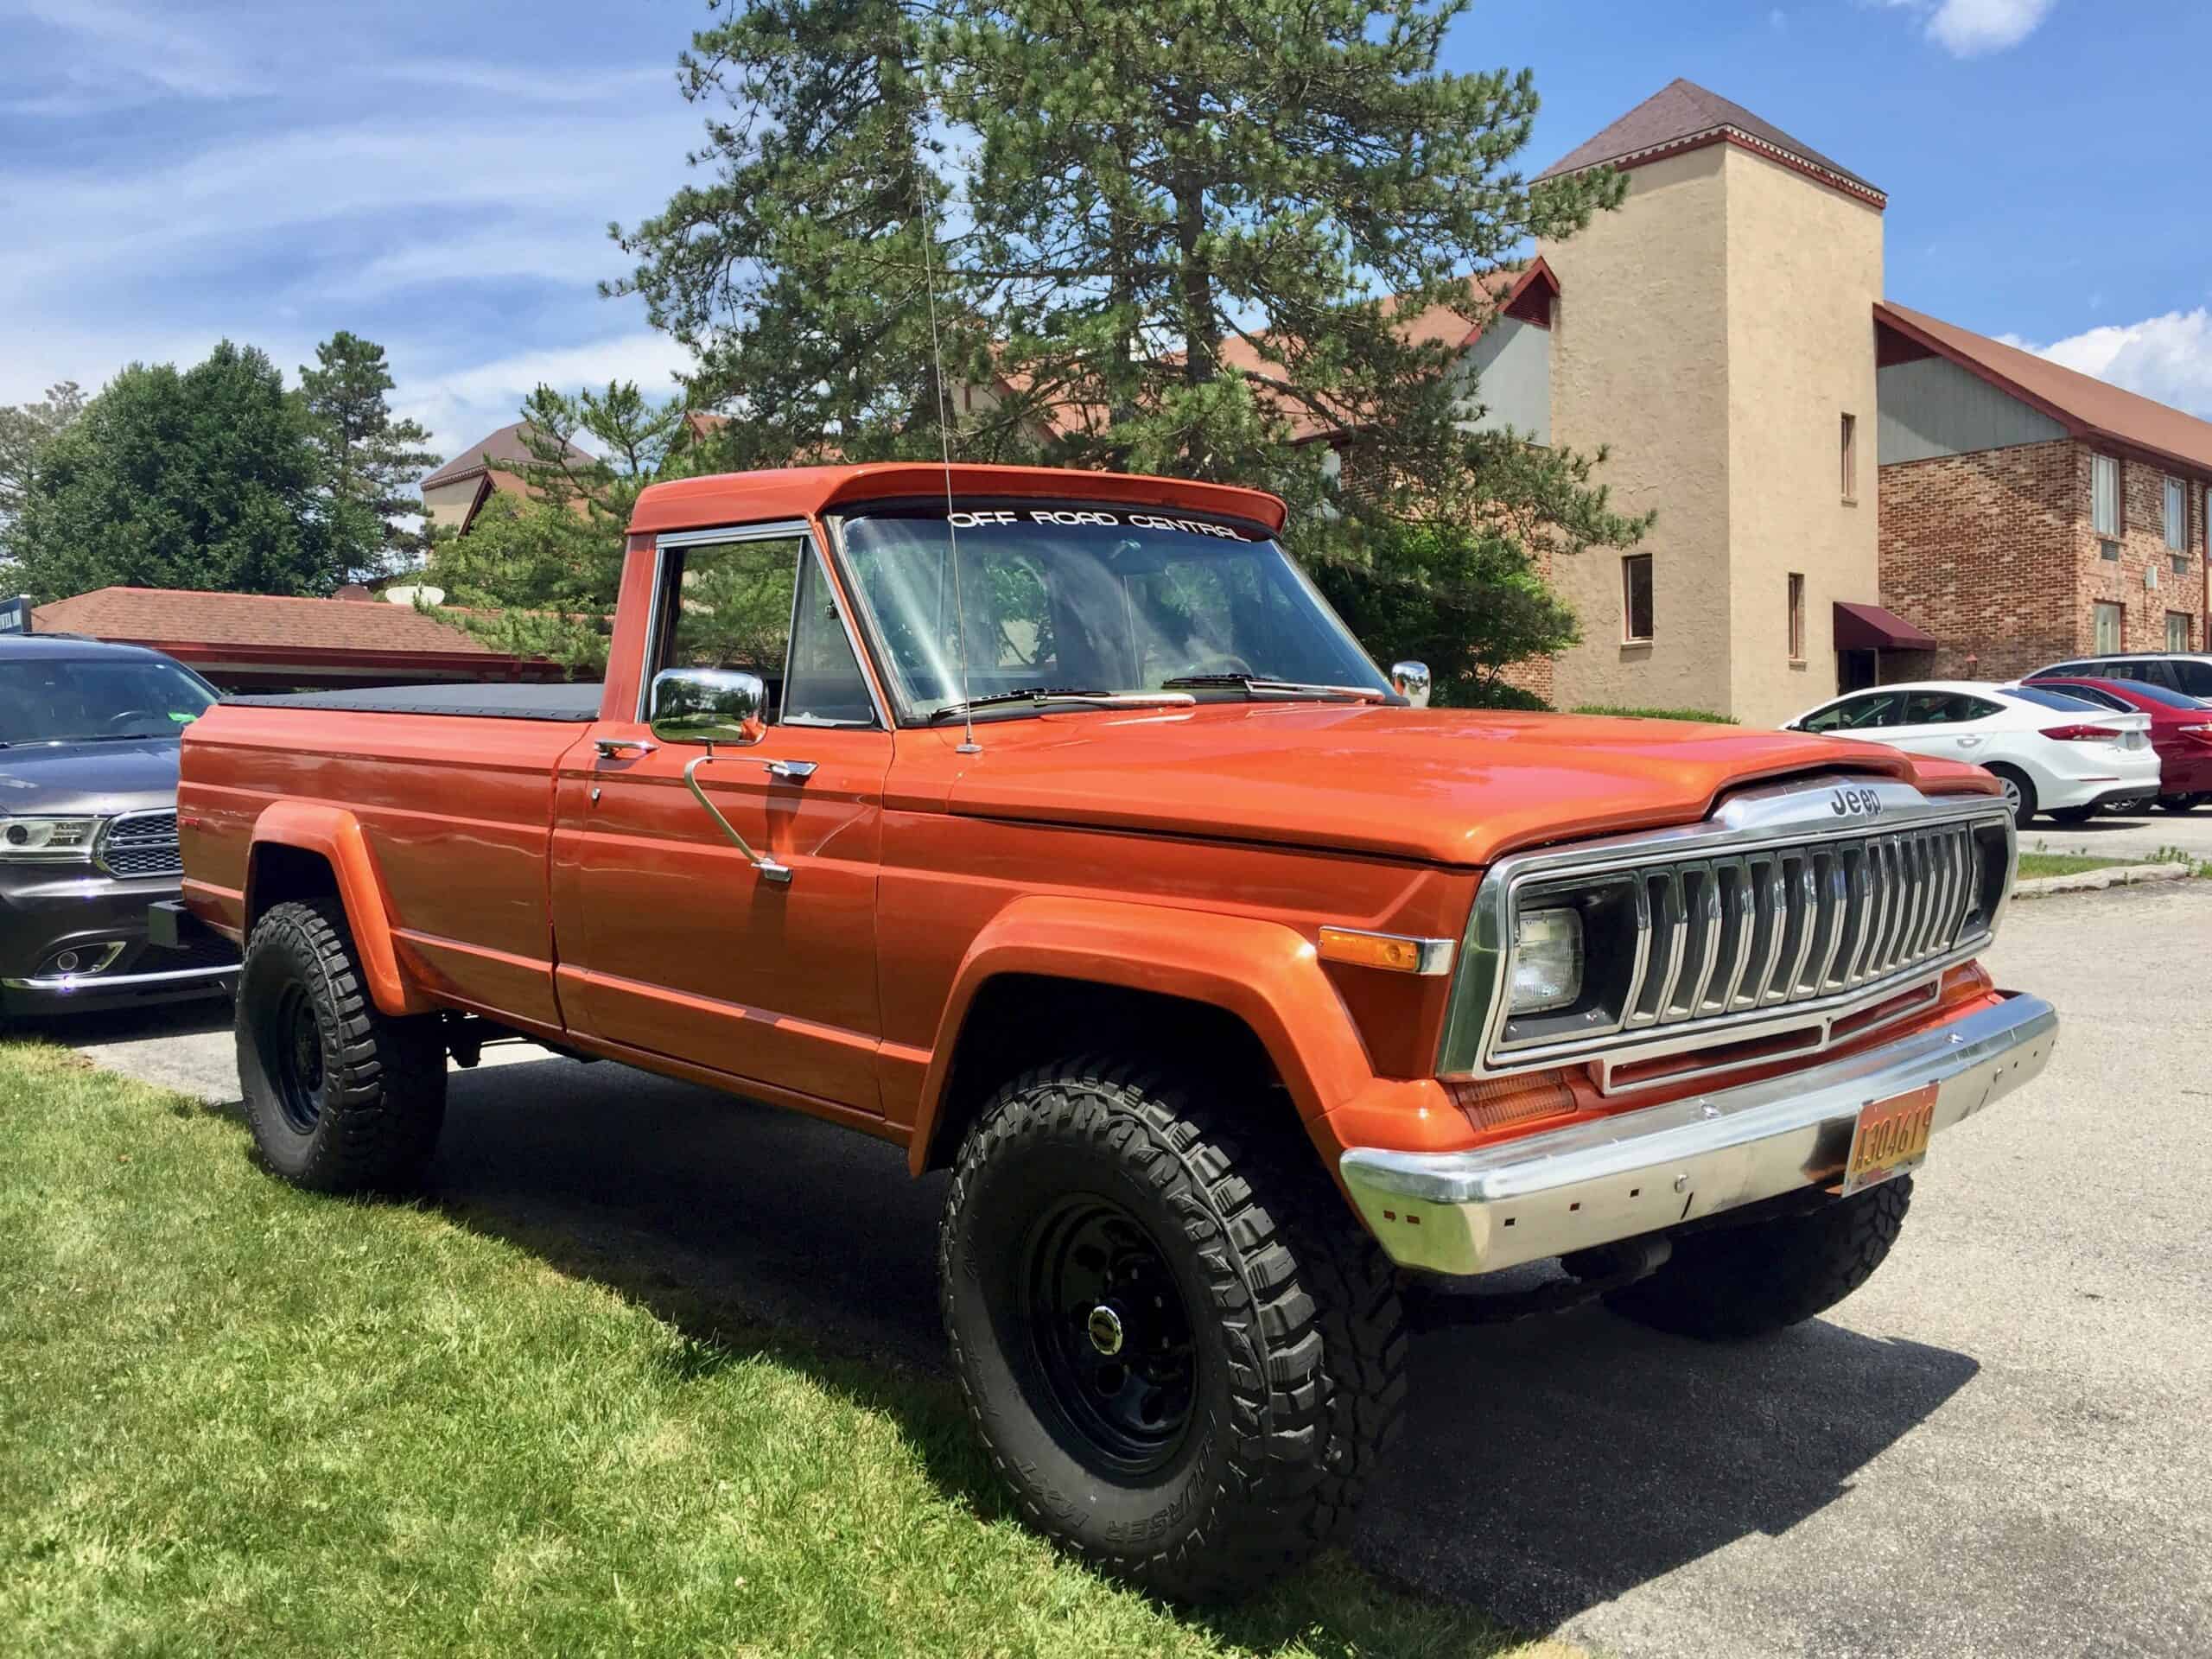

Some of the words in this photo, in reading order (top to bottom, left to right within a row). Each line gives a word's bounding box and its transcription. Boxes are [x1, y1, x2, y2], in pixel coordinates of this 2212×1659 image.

[948, 511, 1018, 528] OFF
[1030, 511, 1119, 526] ROAD
[1128, 514, 1252, 543] CENTRAL
[1831, 788, 1883, 816] Jeep
